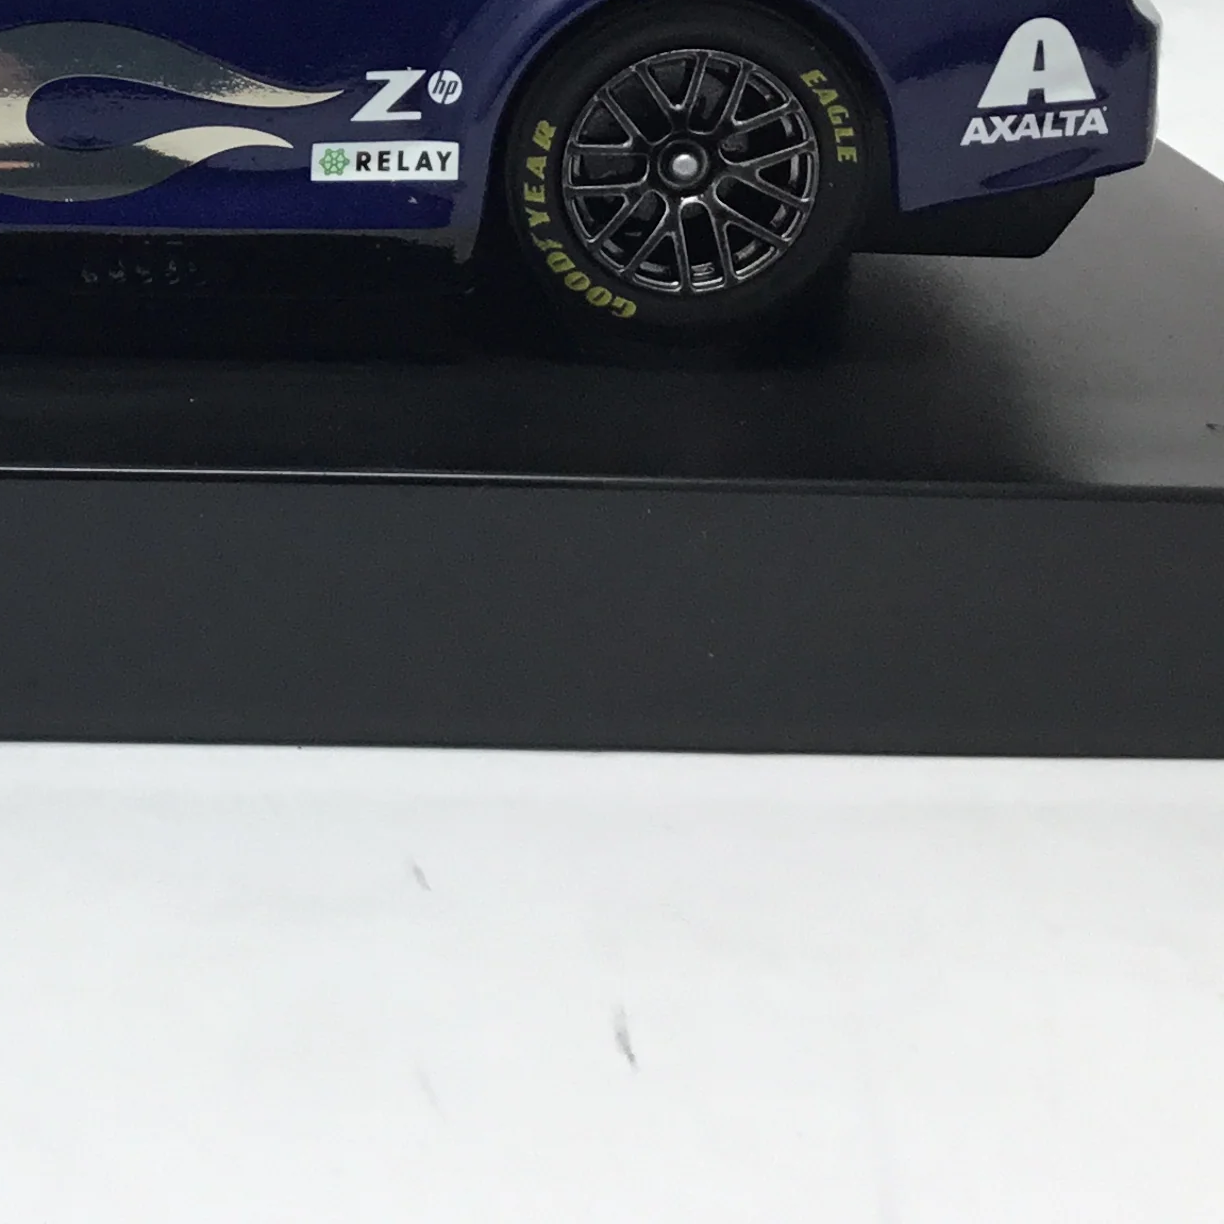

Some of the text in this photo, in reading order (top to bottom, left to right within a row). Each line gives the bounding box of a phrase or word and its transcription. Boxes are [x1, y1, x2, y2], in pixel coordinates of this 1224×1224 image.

[350, 68, 461, 122] Z hp
[799, 68, 858, 164] EAGLE
[959, 105, 1109, 147] AXALTA
[355, 150, 453, 173] RELAY
